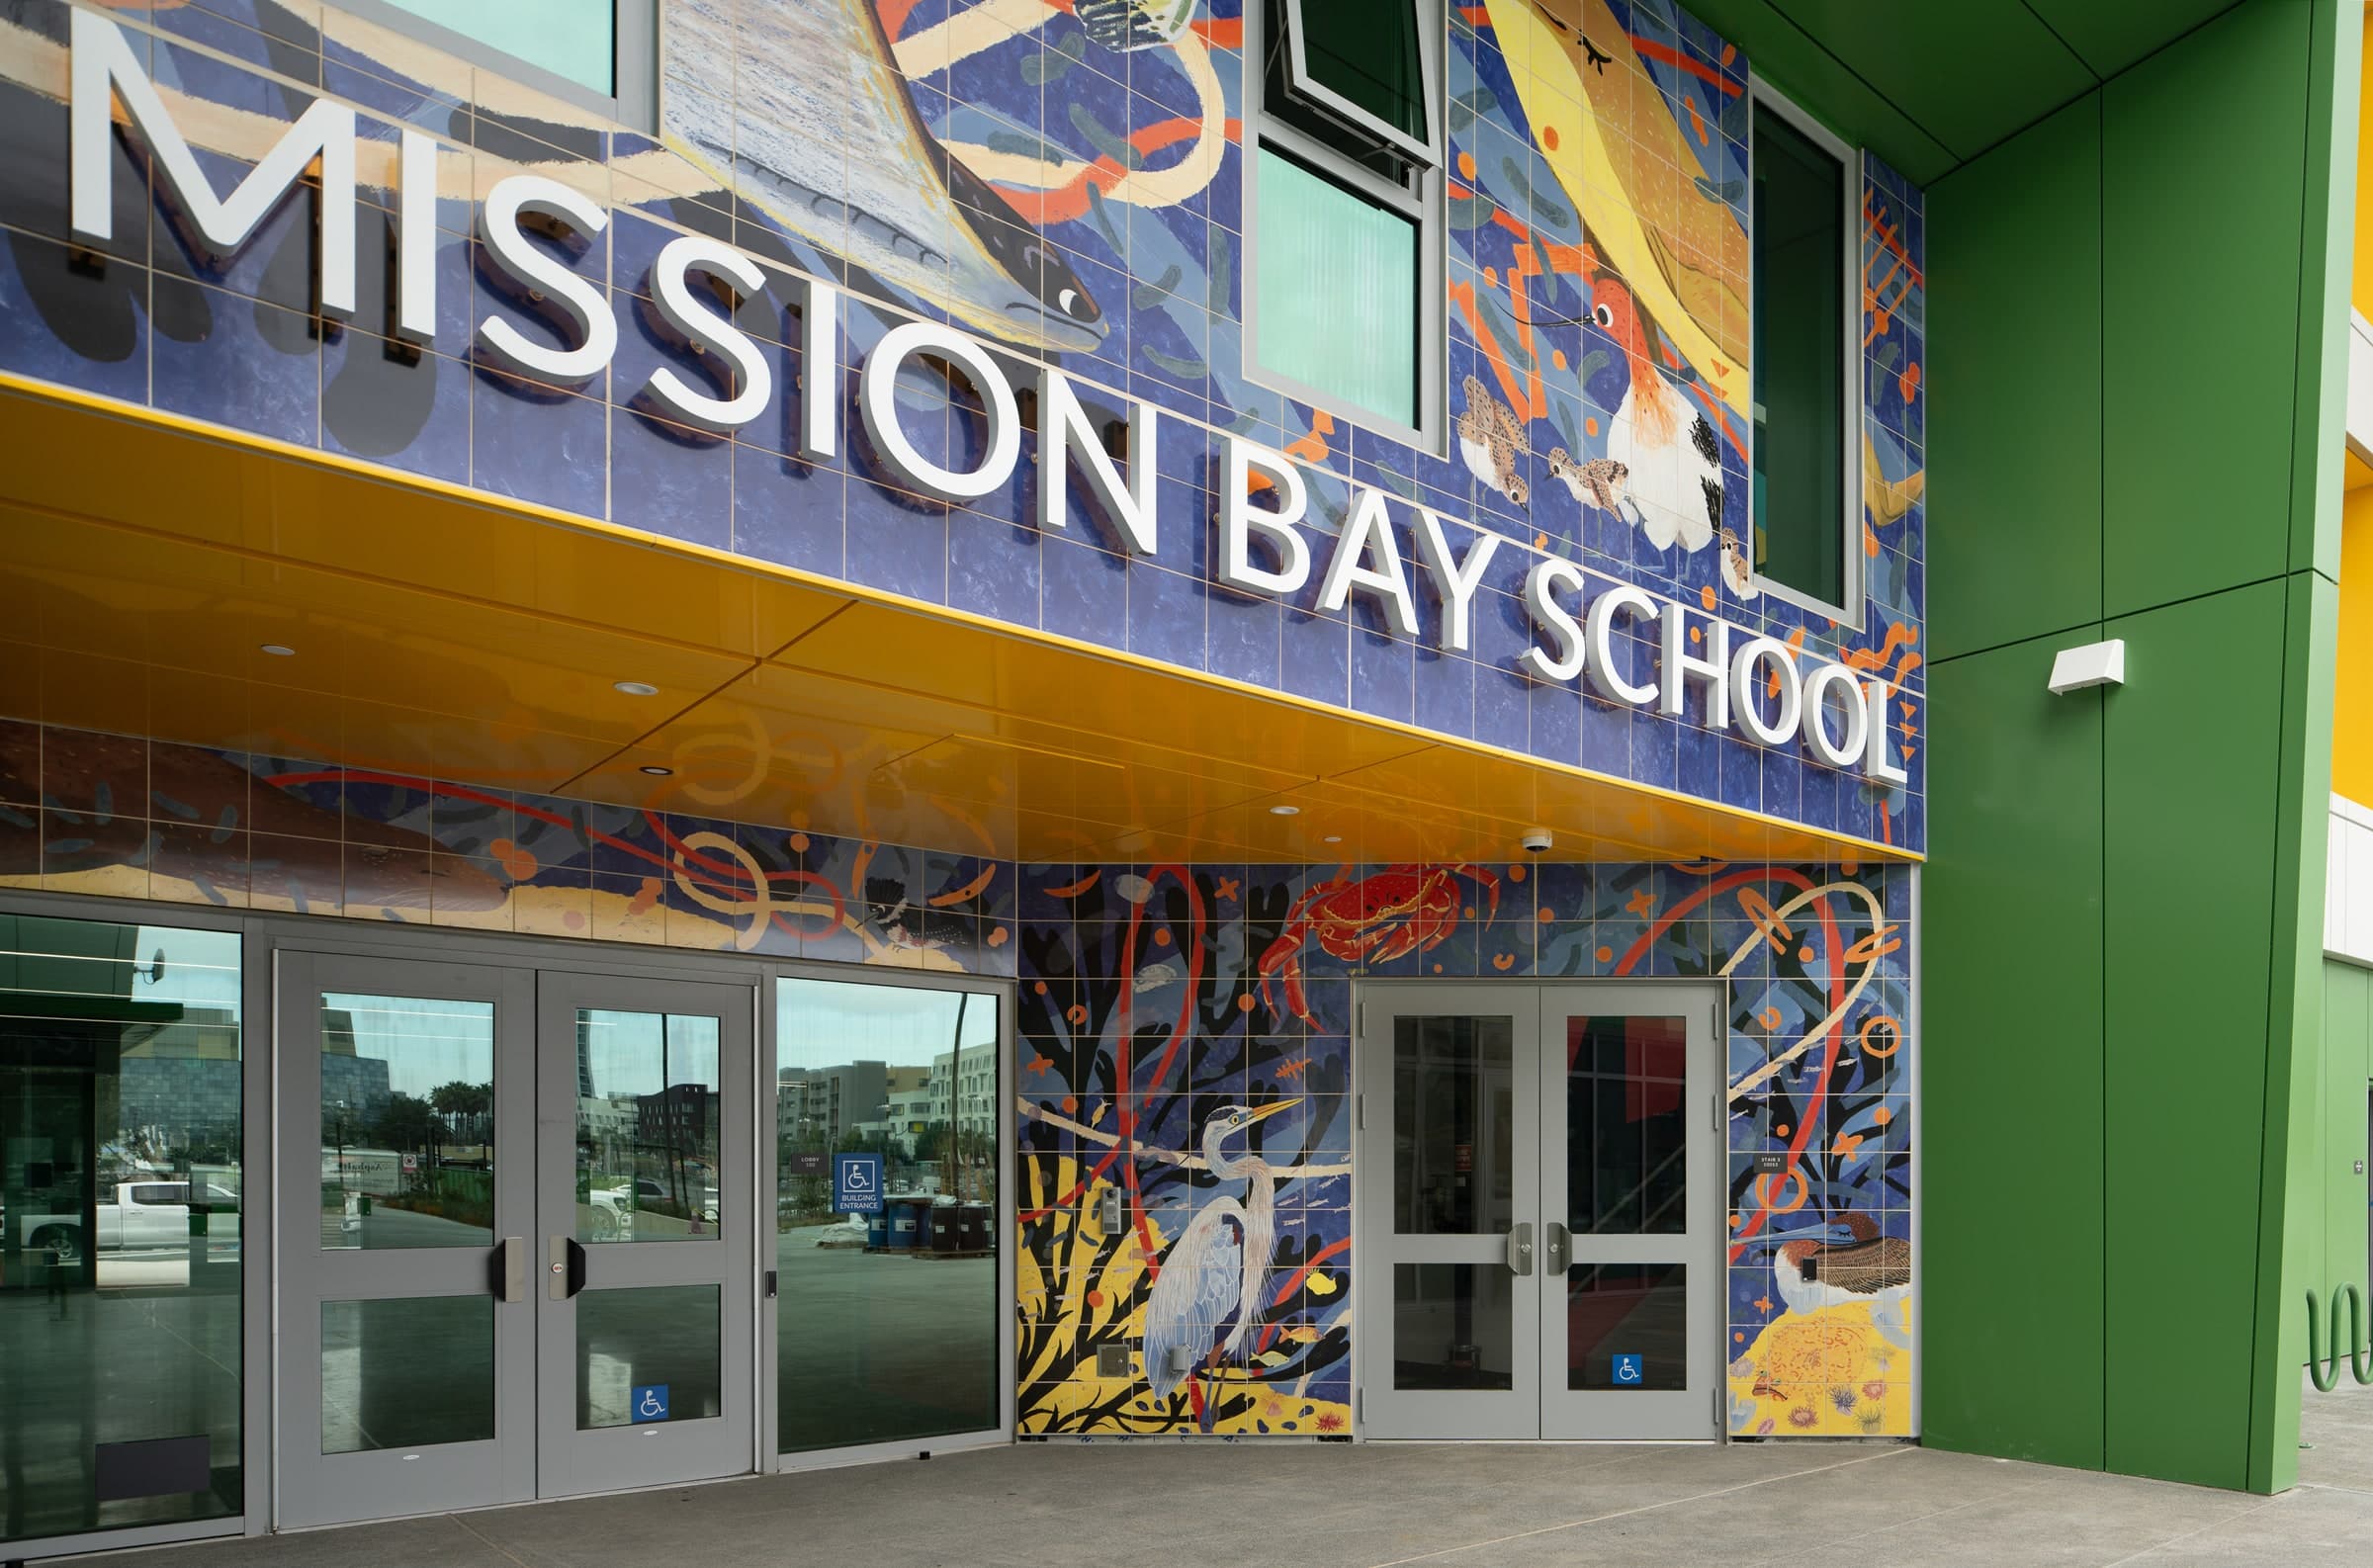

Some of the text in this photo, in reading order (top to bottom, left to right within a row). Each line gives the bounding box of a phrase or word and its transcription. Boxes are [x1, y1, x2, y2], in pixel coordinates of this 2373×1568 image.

[69, 6, 1908, 784] MISSION BAY SCHOOL
